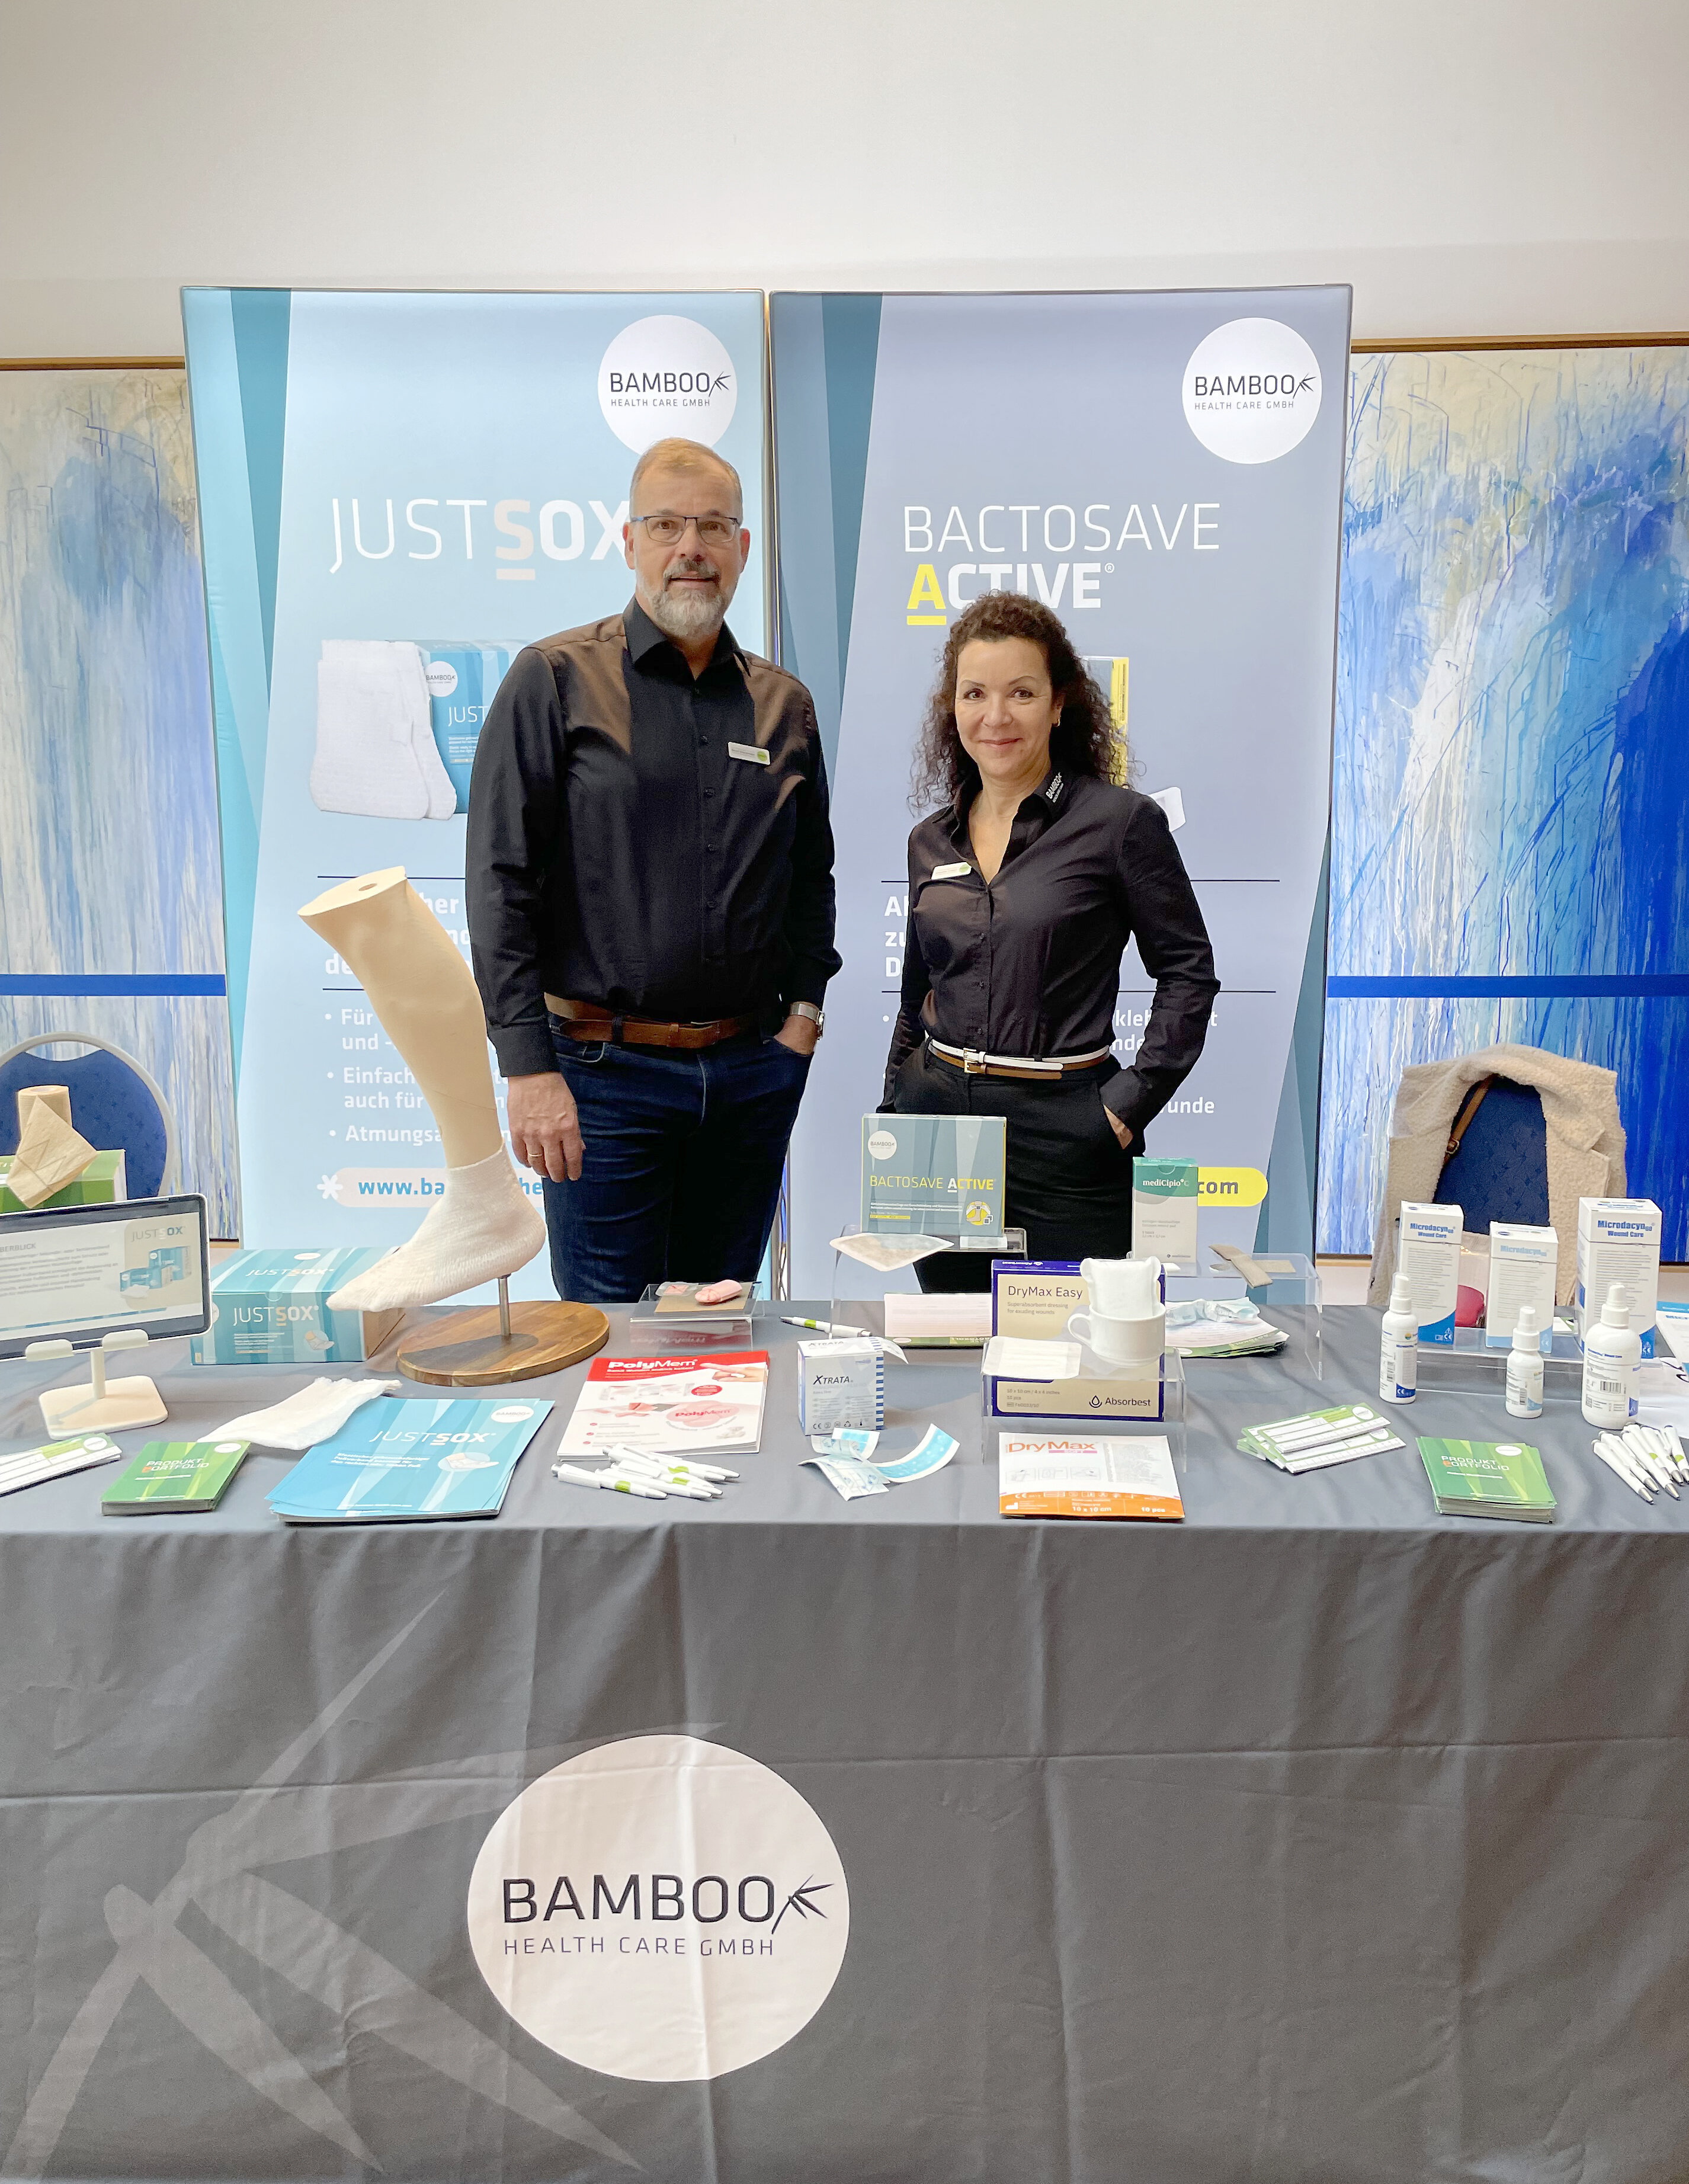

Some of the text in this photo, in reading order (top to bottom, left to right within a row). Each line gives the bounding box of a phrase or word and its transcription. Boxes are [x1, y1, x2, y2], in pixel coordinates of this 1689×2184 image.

[610, 372, 710, 393] BAMBOO
[1195, 374, 1294, 396] BAMBOO
[611, 398, 710, 407] HEALTH CARE GMBH
[1195, 400, 1294, 411] HEALTH CARE GMBH
[904, 503, 1220, 552] BACTOSAVE
[448, 706, 489, 727] JUST
[341, 1008, 373, 1025] Für
[342, 1033, 378, 1050] und
[344, 1091, 424, 1109] auch für
[1160, 1097, 1215, 1114] unde
[870, 1175, 944, 1189] BACTOSAVE
[1008, 1286, 1083, 1300] DryMax Easy
[608, 1359, 696, 1370] PolyMem
[813, 1375, 850, 1385] XTRATA
[1105, 1397, 1151, 1407] Absorbest
[369, 1432, 490, 1446] JUSTSOX
[146, 1458, 204, 1466] PRODUKT
[1441, 1455, 1497, 1465] PRODUKT
[503, 1874, 775, 1923] BAMBOO
[505, 1936, 774, 1956] HEALTH CARE GMBH
